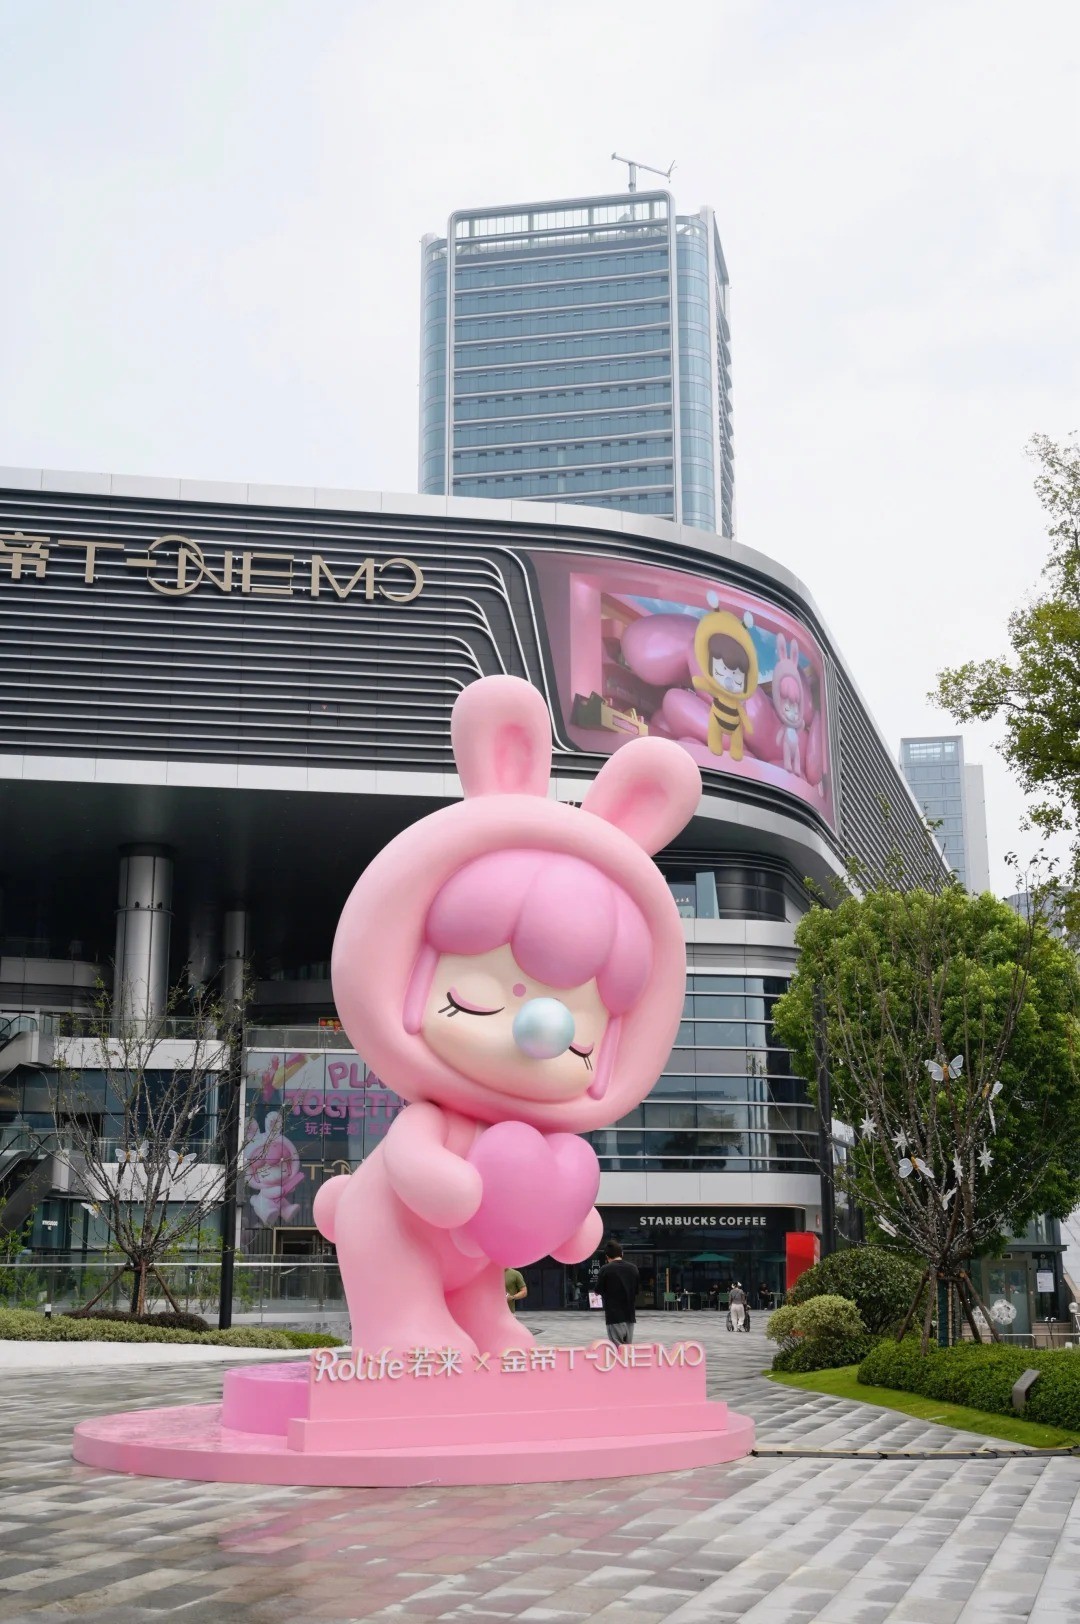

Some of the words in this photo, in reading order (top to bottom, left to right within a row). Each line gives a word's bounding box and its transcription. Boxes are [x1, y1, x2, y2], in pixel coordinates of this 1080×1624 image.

[639, 1216, 717, 1226] STARBUCKS
[719, 1216, 767, 1226] COFFEE
[314, 1347, 404, 1383] Rolife
